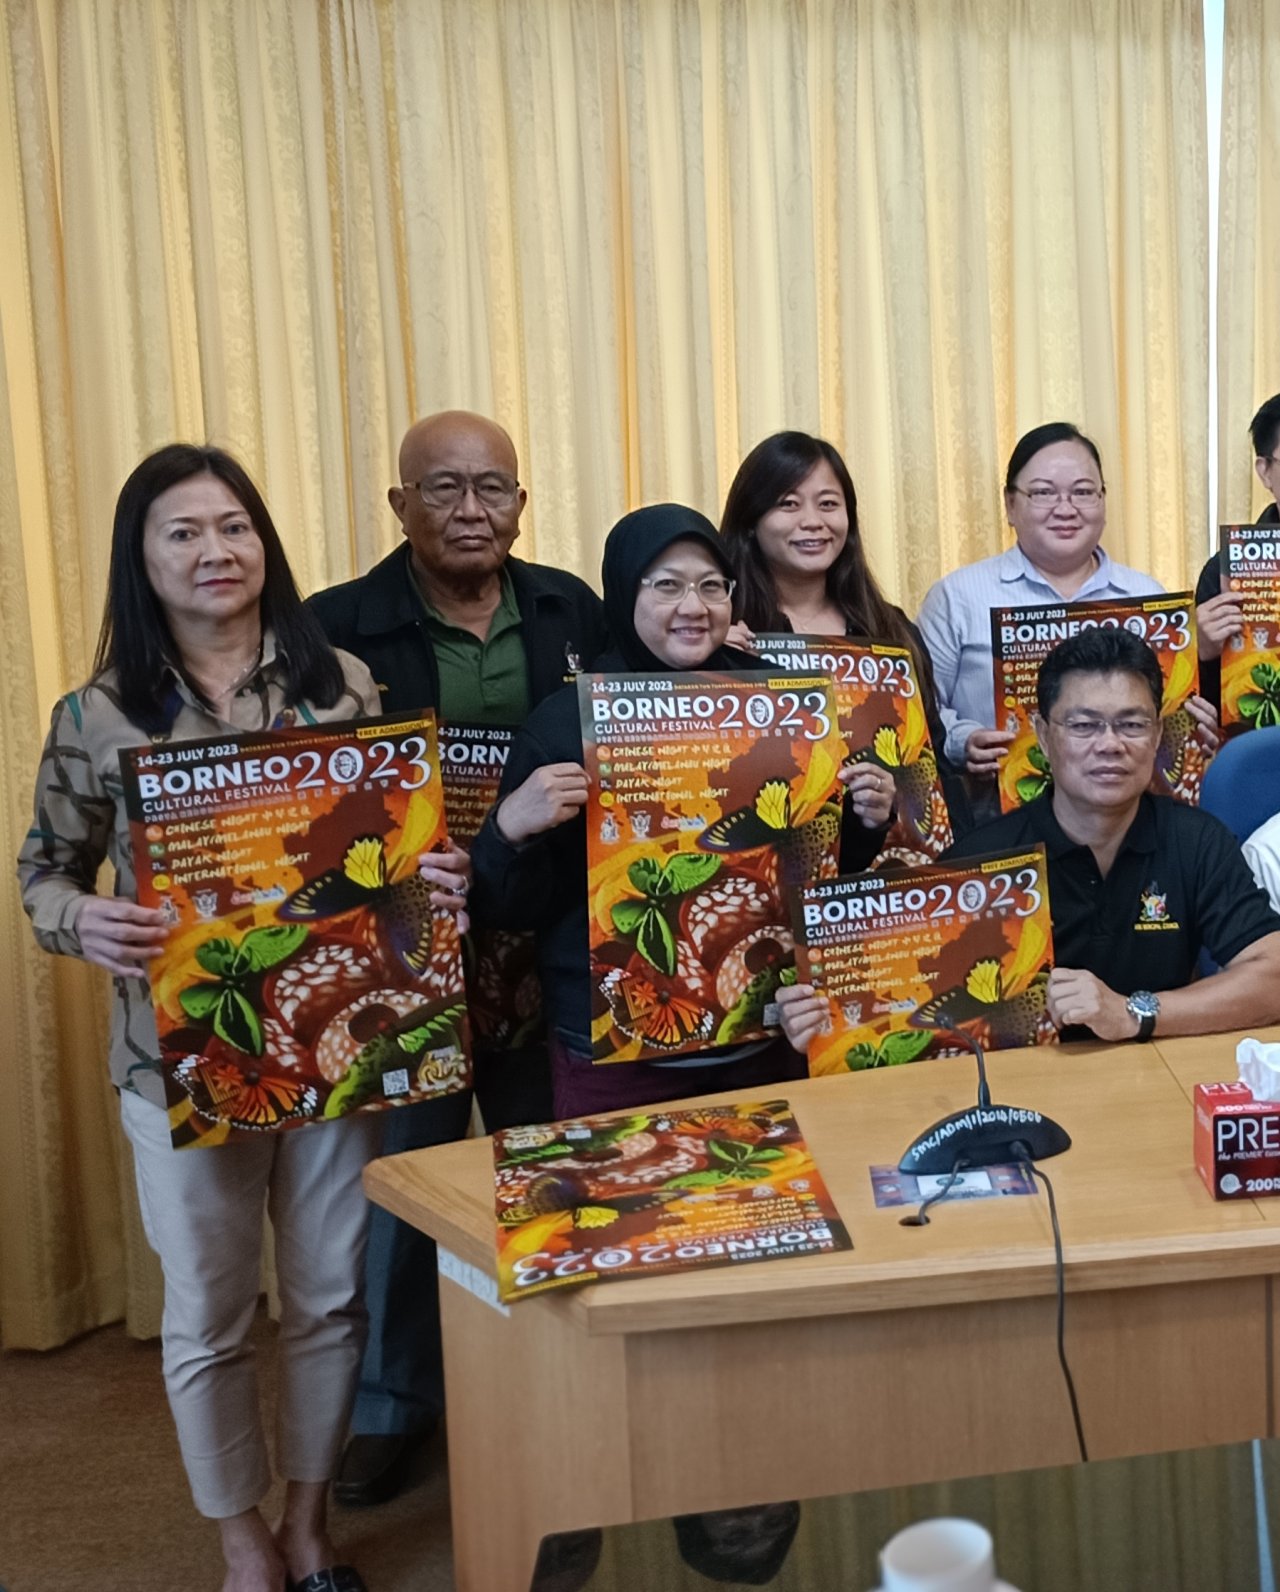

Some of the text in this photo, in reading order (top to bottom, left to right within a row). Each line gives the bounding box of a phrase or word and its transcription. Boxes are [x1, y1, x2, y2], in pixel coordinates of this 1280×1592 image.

[1230, 562, 1277, 571] CULTURAL
[1027, 611, 1044, 620] JULY
[1047, 609, 1066, 619] 2023
[767, 640, 786, 649] JULY
[1002, 643, 1052, 654] CULTURAL
[592, 682, 621, 693] 14-23
[623, 682, 645, 692] JULY
[648, 681, 673, 691] 2023
[593, 692, 830, 740] BORNEO 2023
[462, 729, 485, 739] JULY
[487, 731, 511, 740] 2023
[595, 720, 715, 734] CULTURAL FESTIVAL
[137, 744, 238, 767] 14-23 JULY 2023
[613, 746, 654, 757] CHINESE
[658, 745, 688, 755] NIGHT
[138, 737, 431, 798] BORNEO 2023
[616, 779, 649, 788] DAYAK
[143, 792, 220, 813] CULTURAL
[225, 783, 290, 800] FESTIVAL
[166, 813, 258, 835] CHINESE NIGHT
[276, 820, 311, 833] NIGHT
[172, 848, 253, 870] DAYAK NIGHT
[174, 852, 310, 885] INTERNATIONAL NIGHT
[804, 879, 884, 899] 14-23 JULY 2023
[804, 889, 926, 926] BORNEO
[928, 868, 1041, 919] 2023
[806, 922, 869, 938] CULTURAL
[872, 913, 926, 930] FESTIVAL
[1246, 1178, 1272, 1191] 200
[676, 1222, 828, 1248] CULTURAL FESTIVAL
